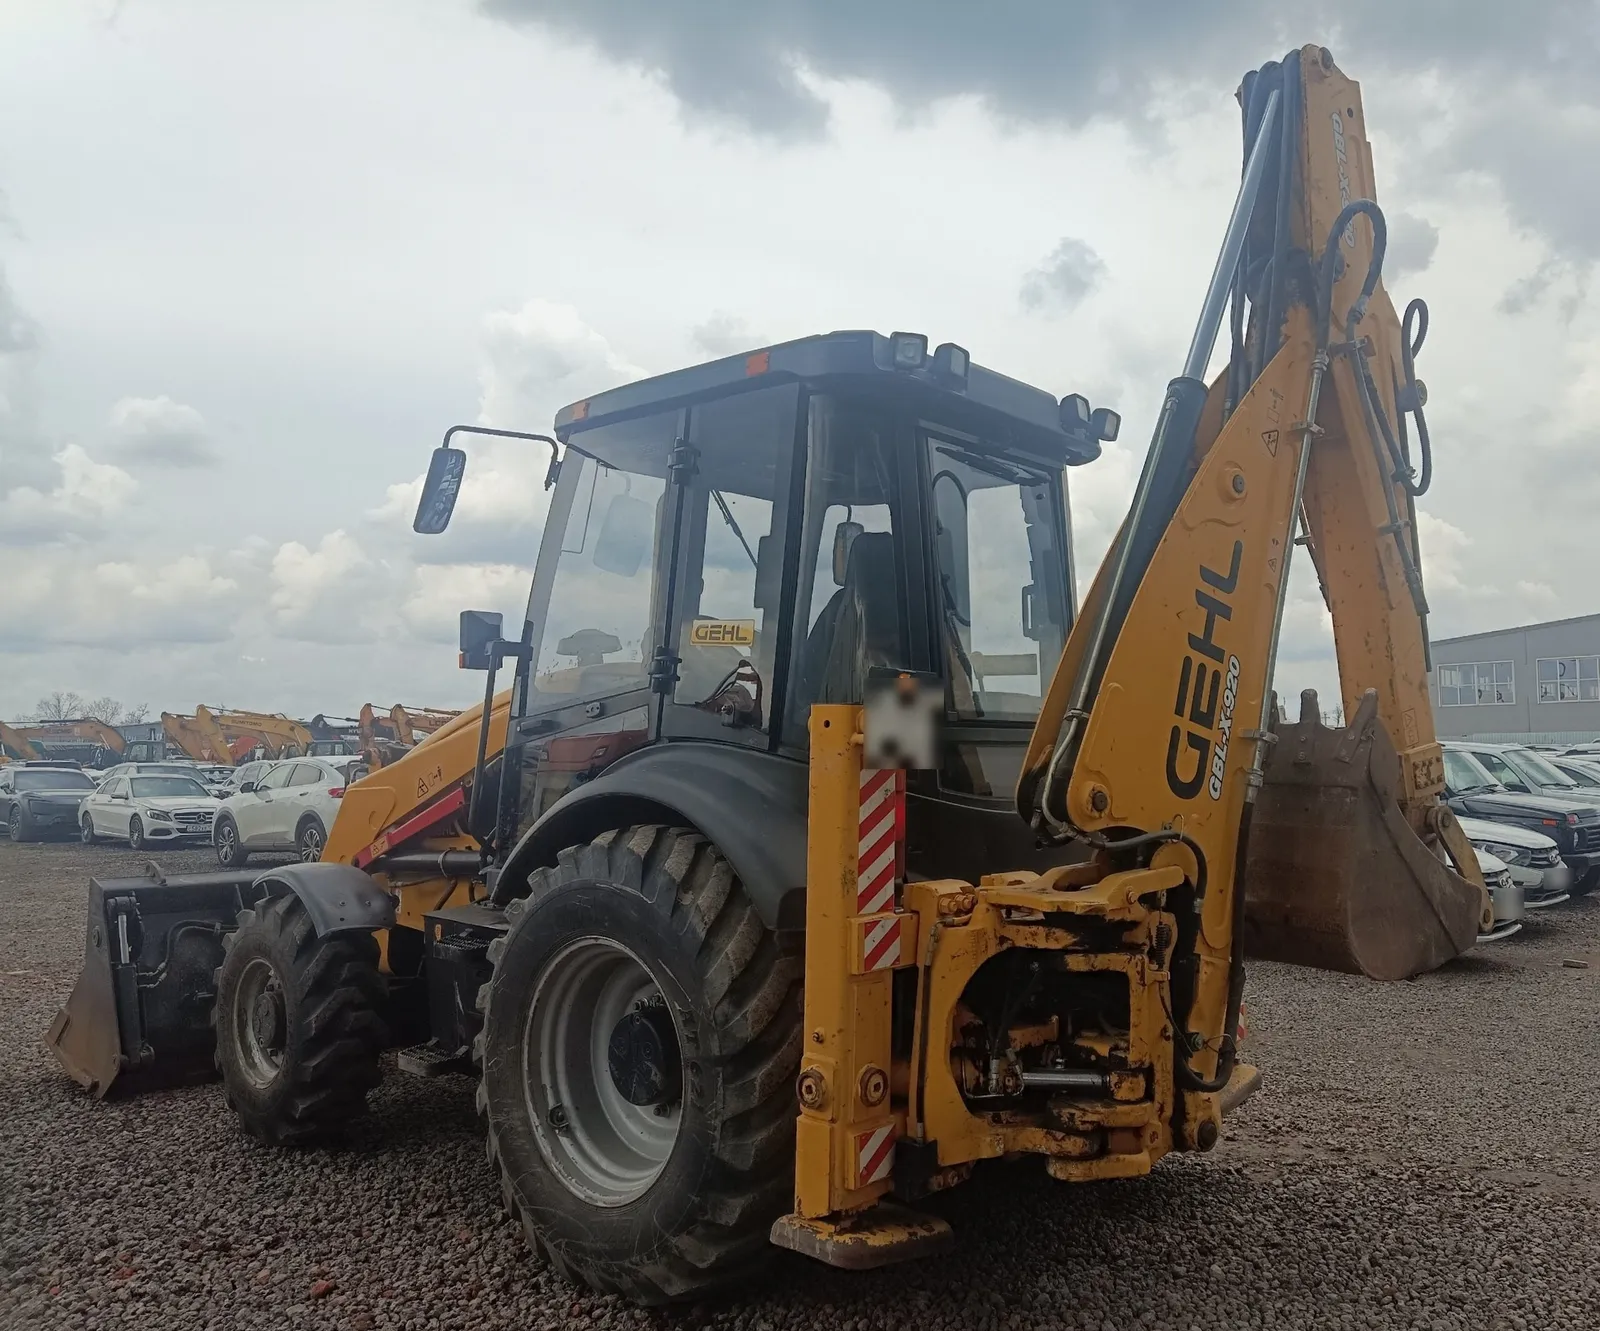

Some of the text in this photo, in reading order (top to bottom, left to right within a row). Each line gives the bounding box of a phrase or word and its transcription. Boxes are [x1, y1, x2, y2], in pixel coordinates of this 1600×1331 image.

[695, 624, 748, 641] GEHL
[1165, 540, 1243, 799] GEHL
[1208, 654, 1240, 801] GBL-X-920
